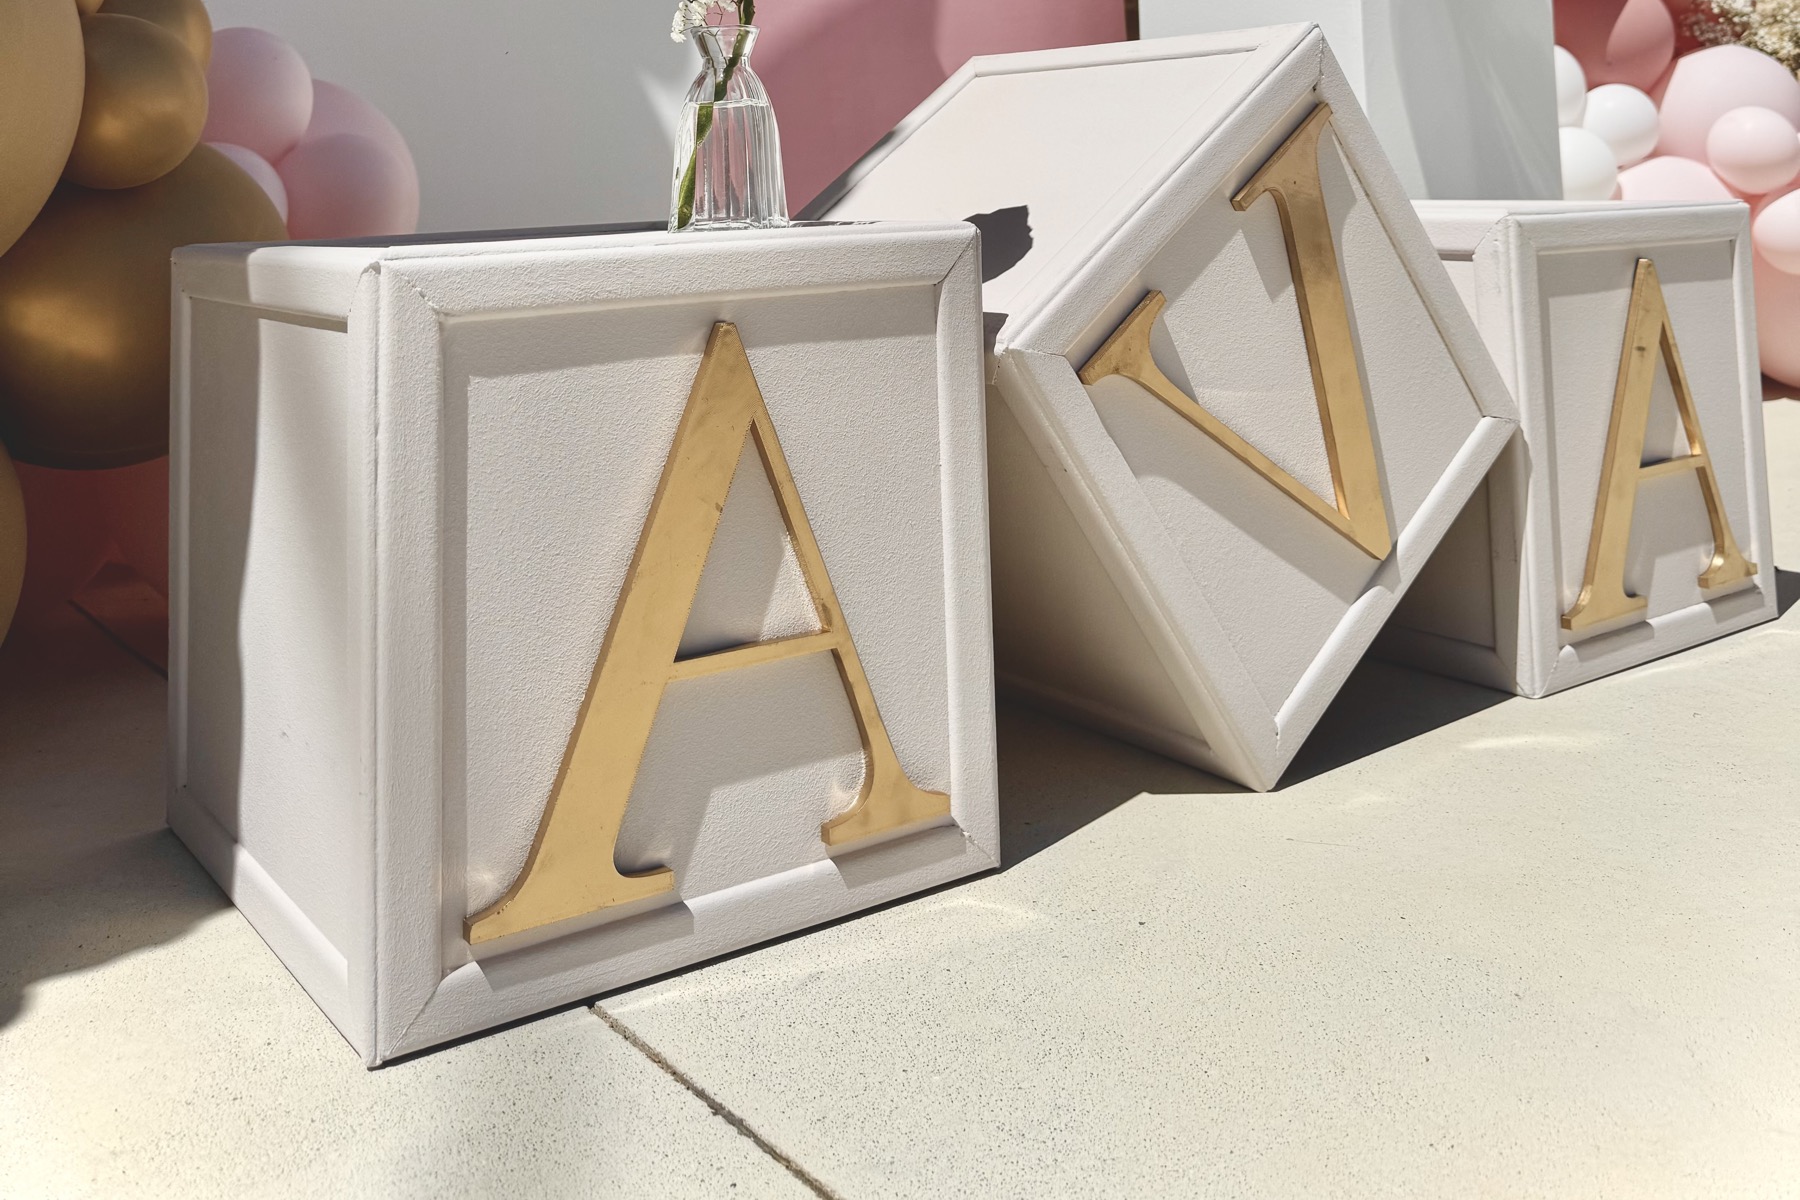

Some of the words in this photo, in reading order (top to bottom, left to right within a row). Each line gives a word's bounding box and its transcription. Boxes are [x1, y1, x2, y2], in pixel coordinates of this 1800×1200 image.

[1078, 103, 1393, 561] V
[1560, 258, 1758, 631] A
[463, 322, 951, 945] A
